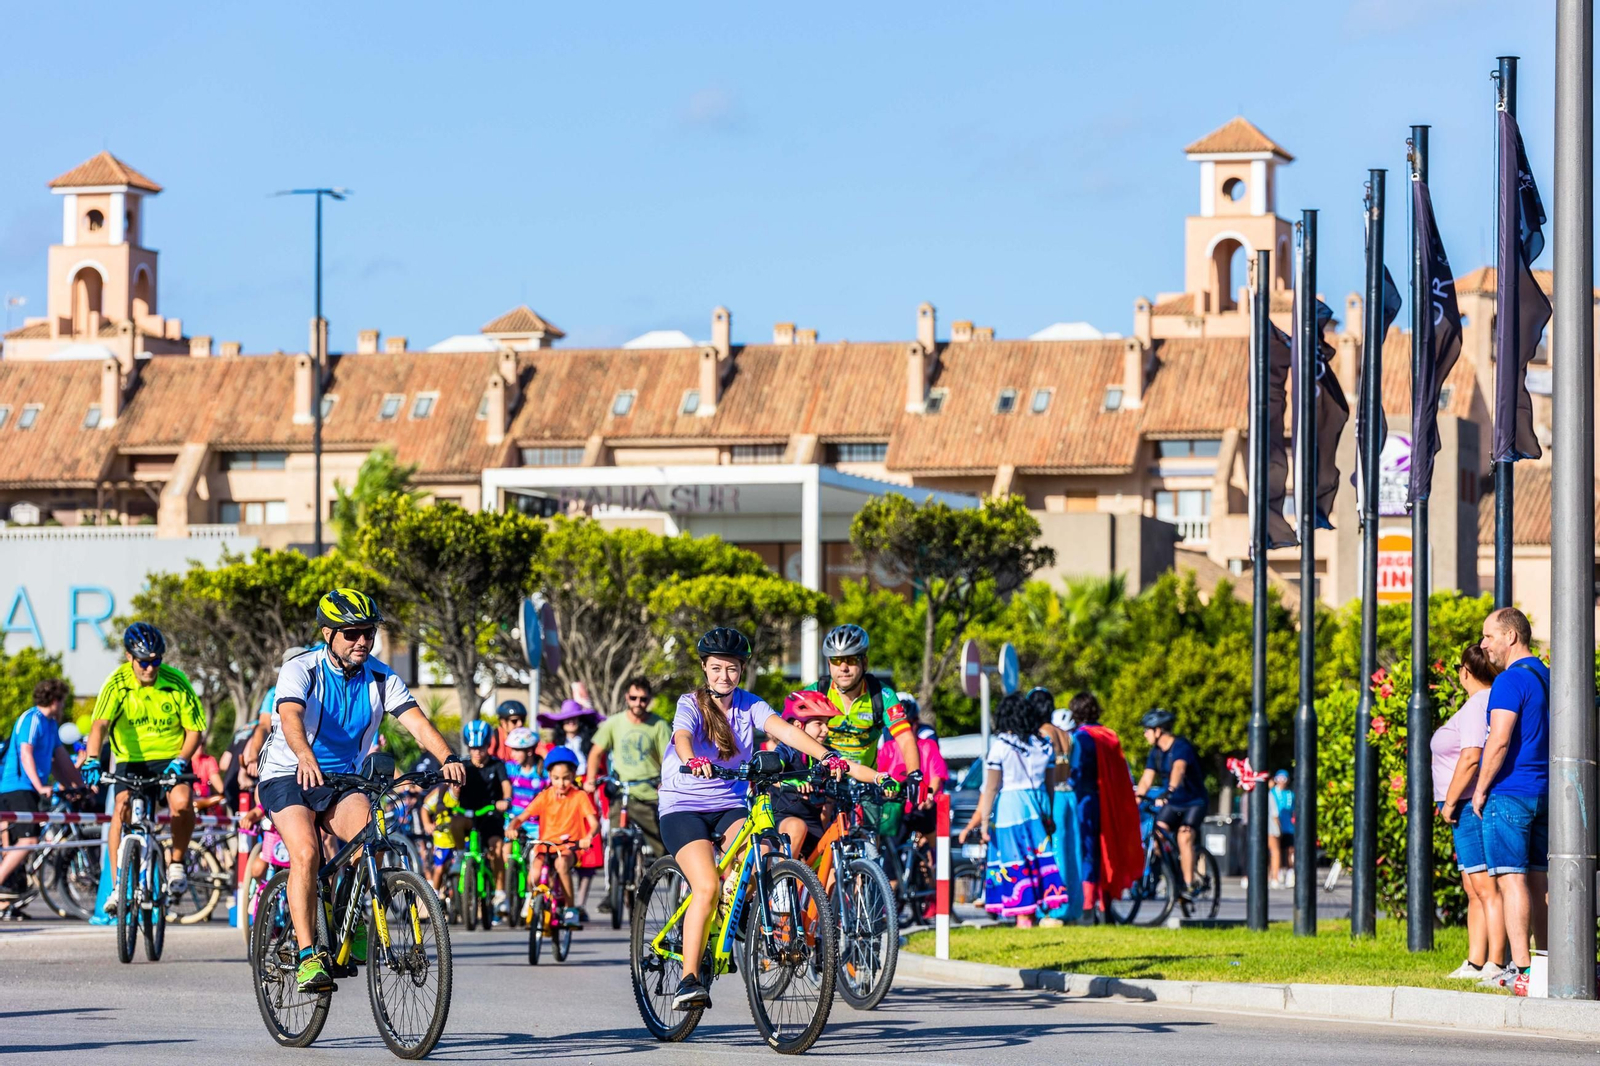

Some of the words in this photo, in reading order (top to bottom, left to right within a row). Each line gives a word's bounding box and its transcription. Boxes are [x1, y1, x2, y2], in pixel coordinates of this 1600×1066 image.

[1432, 277, 1454, 326] UR
[1377, 570, 1413, 588] IN
[2, 585, 115, 652] AR
[128, 715, 173, 727] SAMUNG
